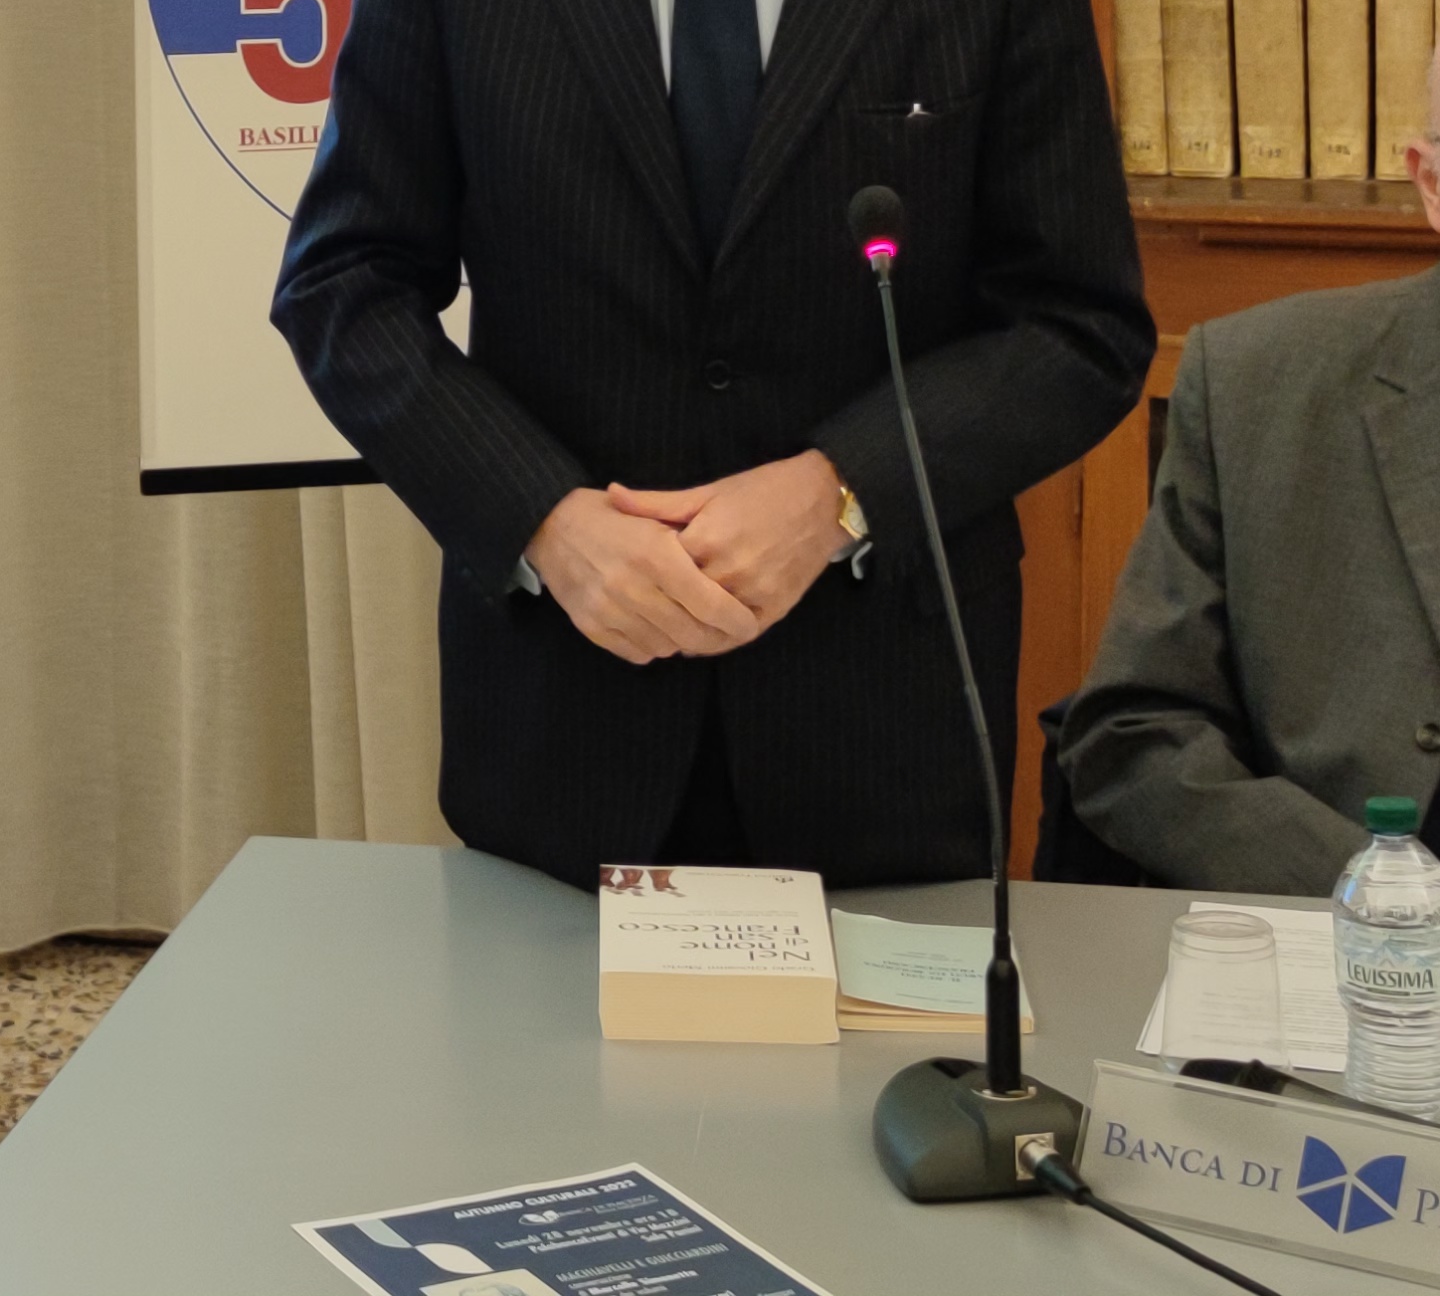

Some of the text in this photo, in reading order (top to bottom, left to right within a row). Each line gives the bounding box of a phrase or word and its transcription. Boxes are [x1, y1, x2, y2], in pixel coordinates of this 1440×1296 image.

[748, 950, 811, 962] Nel
[1346, 957, 1434, 990] LEVISSIMA
[1101, 1121, 1225, 1182] BANCA
[1240, 1159, 1284, 1193] DI
[453, 1200, 524, 1220] AUTUNNO
[524, 1187, 600, 1208] CULTURALE
